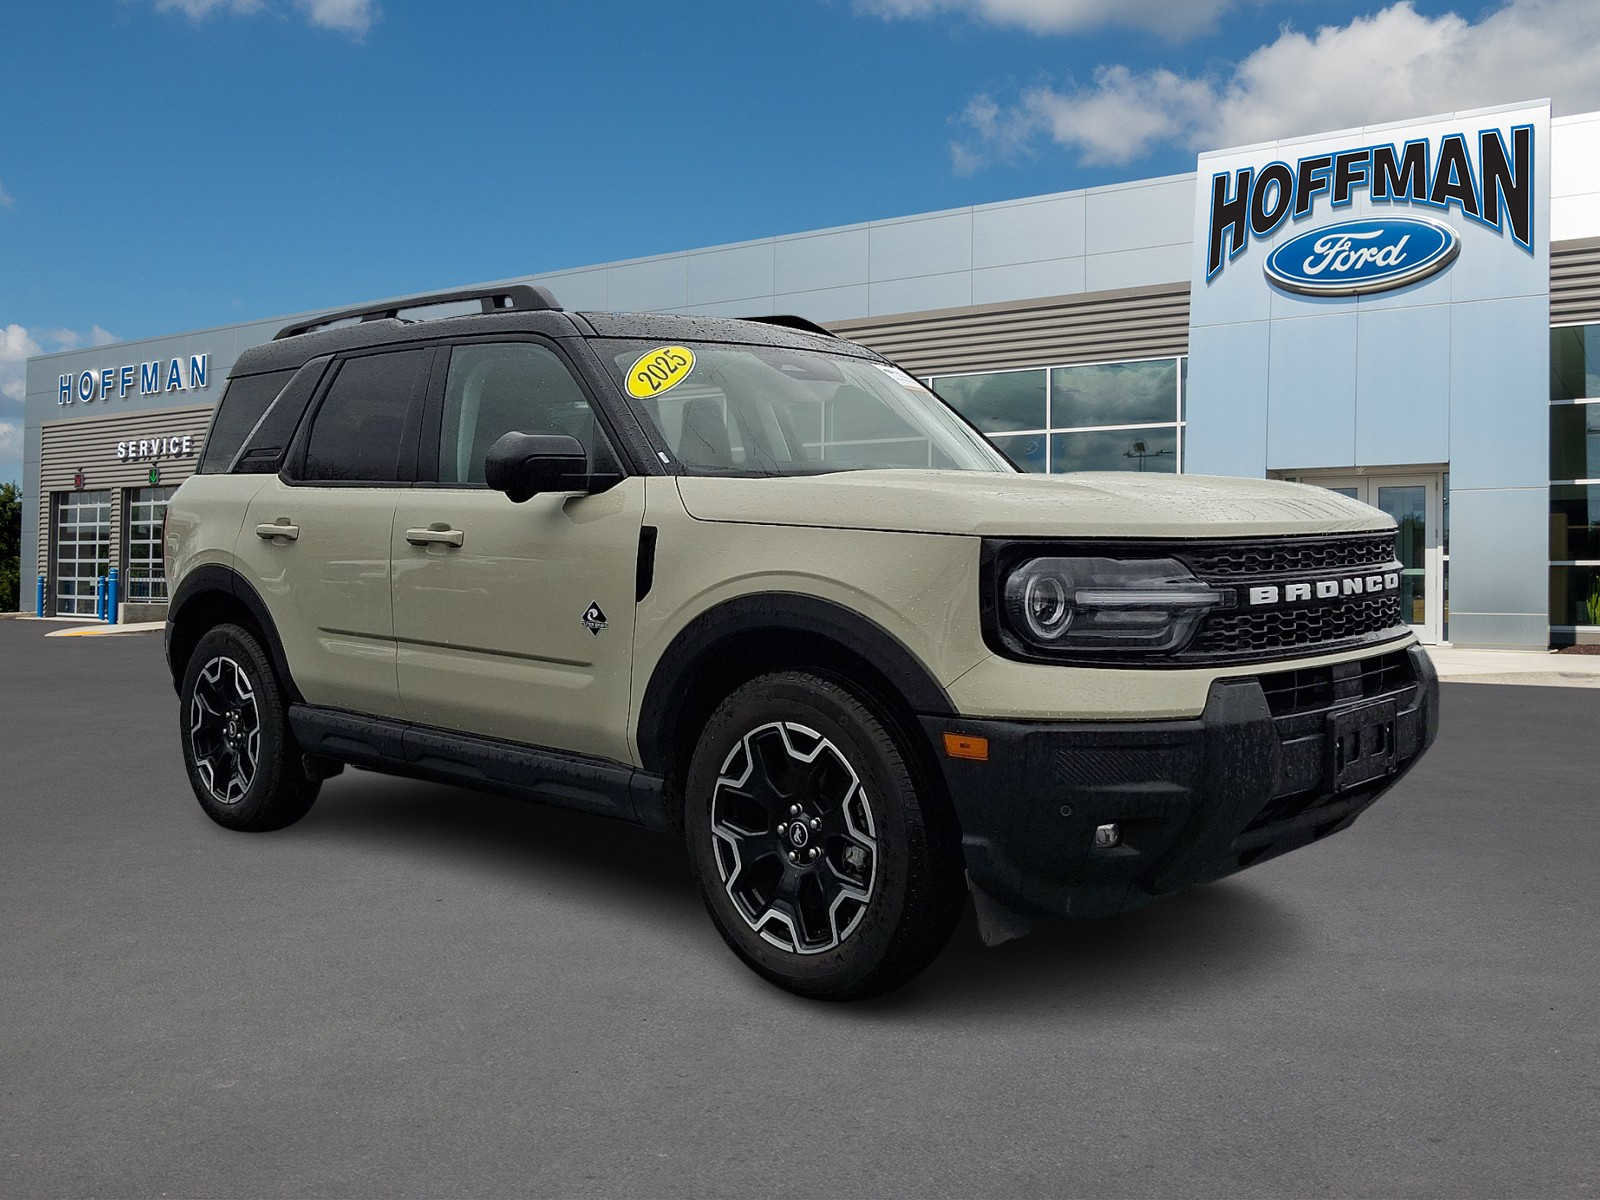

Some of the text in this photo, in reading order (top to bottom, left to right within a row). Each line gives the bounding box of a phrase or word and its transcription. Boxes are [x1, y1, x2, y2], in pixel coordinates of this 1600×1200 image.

[1206, 123, 1535, 283] HOFFMAN
[1302, 229, 1410, 275] Ford
[57, 353, 209, 405] HOFFMAN
[638, 350, 687, 391] 2025
[117, 436, 192, 459] SERVICE
[1249, 573, 1399, 605] BRONCO
